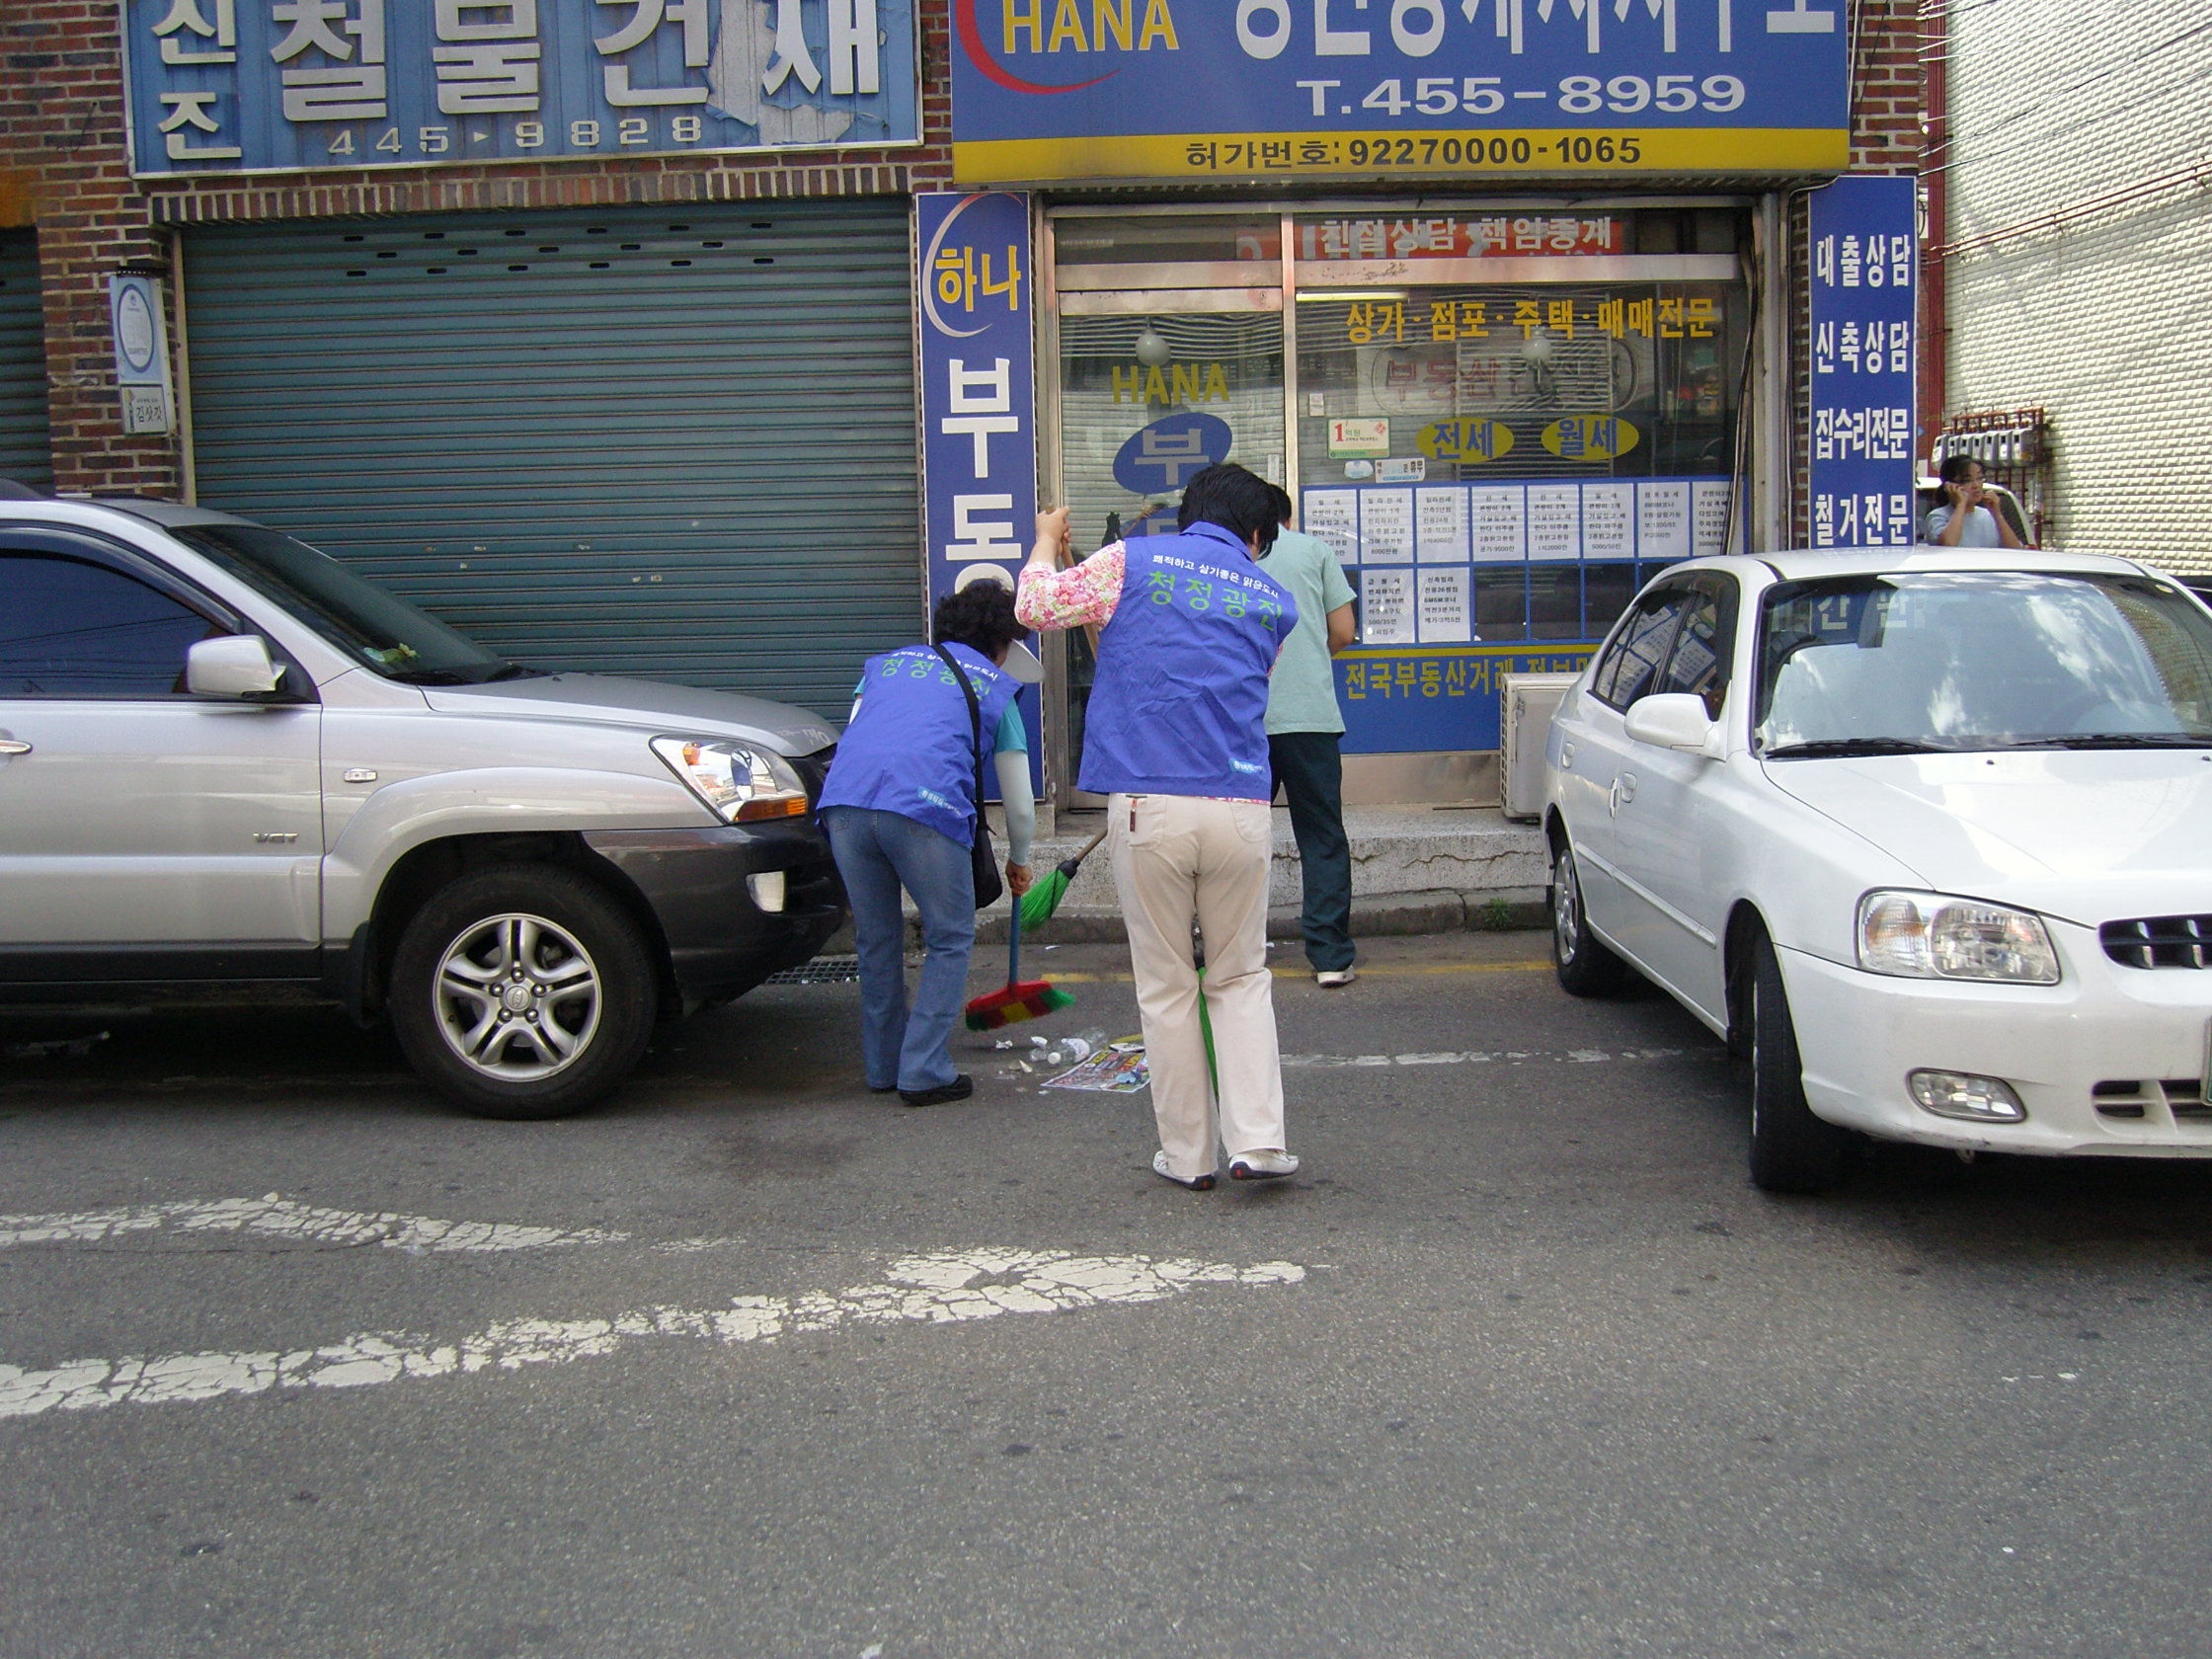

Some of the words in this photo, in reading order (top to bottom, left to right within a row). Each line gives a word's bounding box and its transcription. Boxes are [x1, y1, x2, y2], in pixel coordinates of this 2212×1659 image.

[1003, 0, 1179, 53] HANA
[1320, 217, 1456, 253] 친절상담
[1817, 234, 1910, 287] 대출상담
[935, 245, 1021, 312] 하나
[1816, 321, 1909, 373] 신축상담
[1113, 363, 1229, 404] HANA
[1433, 420, 1494, 459] 전세
[1557, 418, 1618, 456] 월세
[1816, 407, 1908, 460] 집수리전문
[1815, 493, 1908, 546] 철거전문
[1147, 571, 1282, 631] 청정광진
[1152, 555, 1195, 570] 쾌적하고
[1199, 564, 1239, 584] 살기좋은
[1242, 576, 1280, 599] 맑은도시
